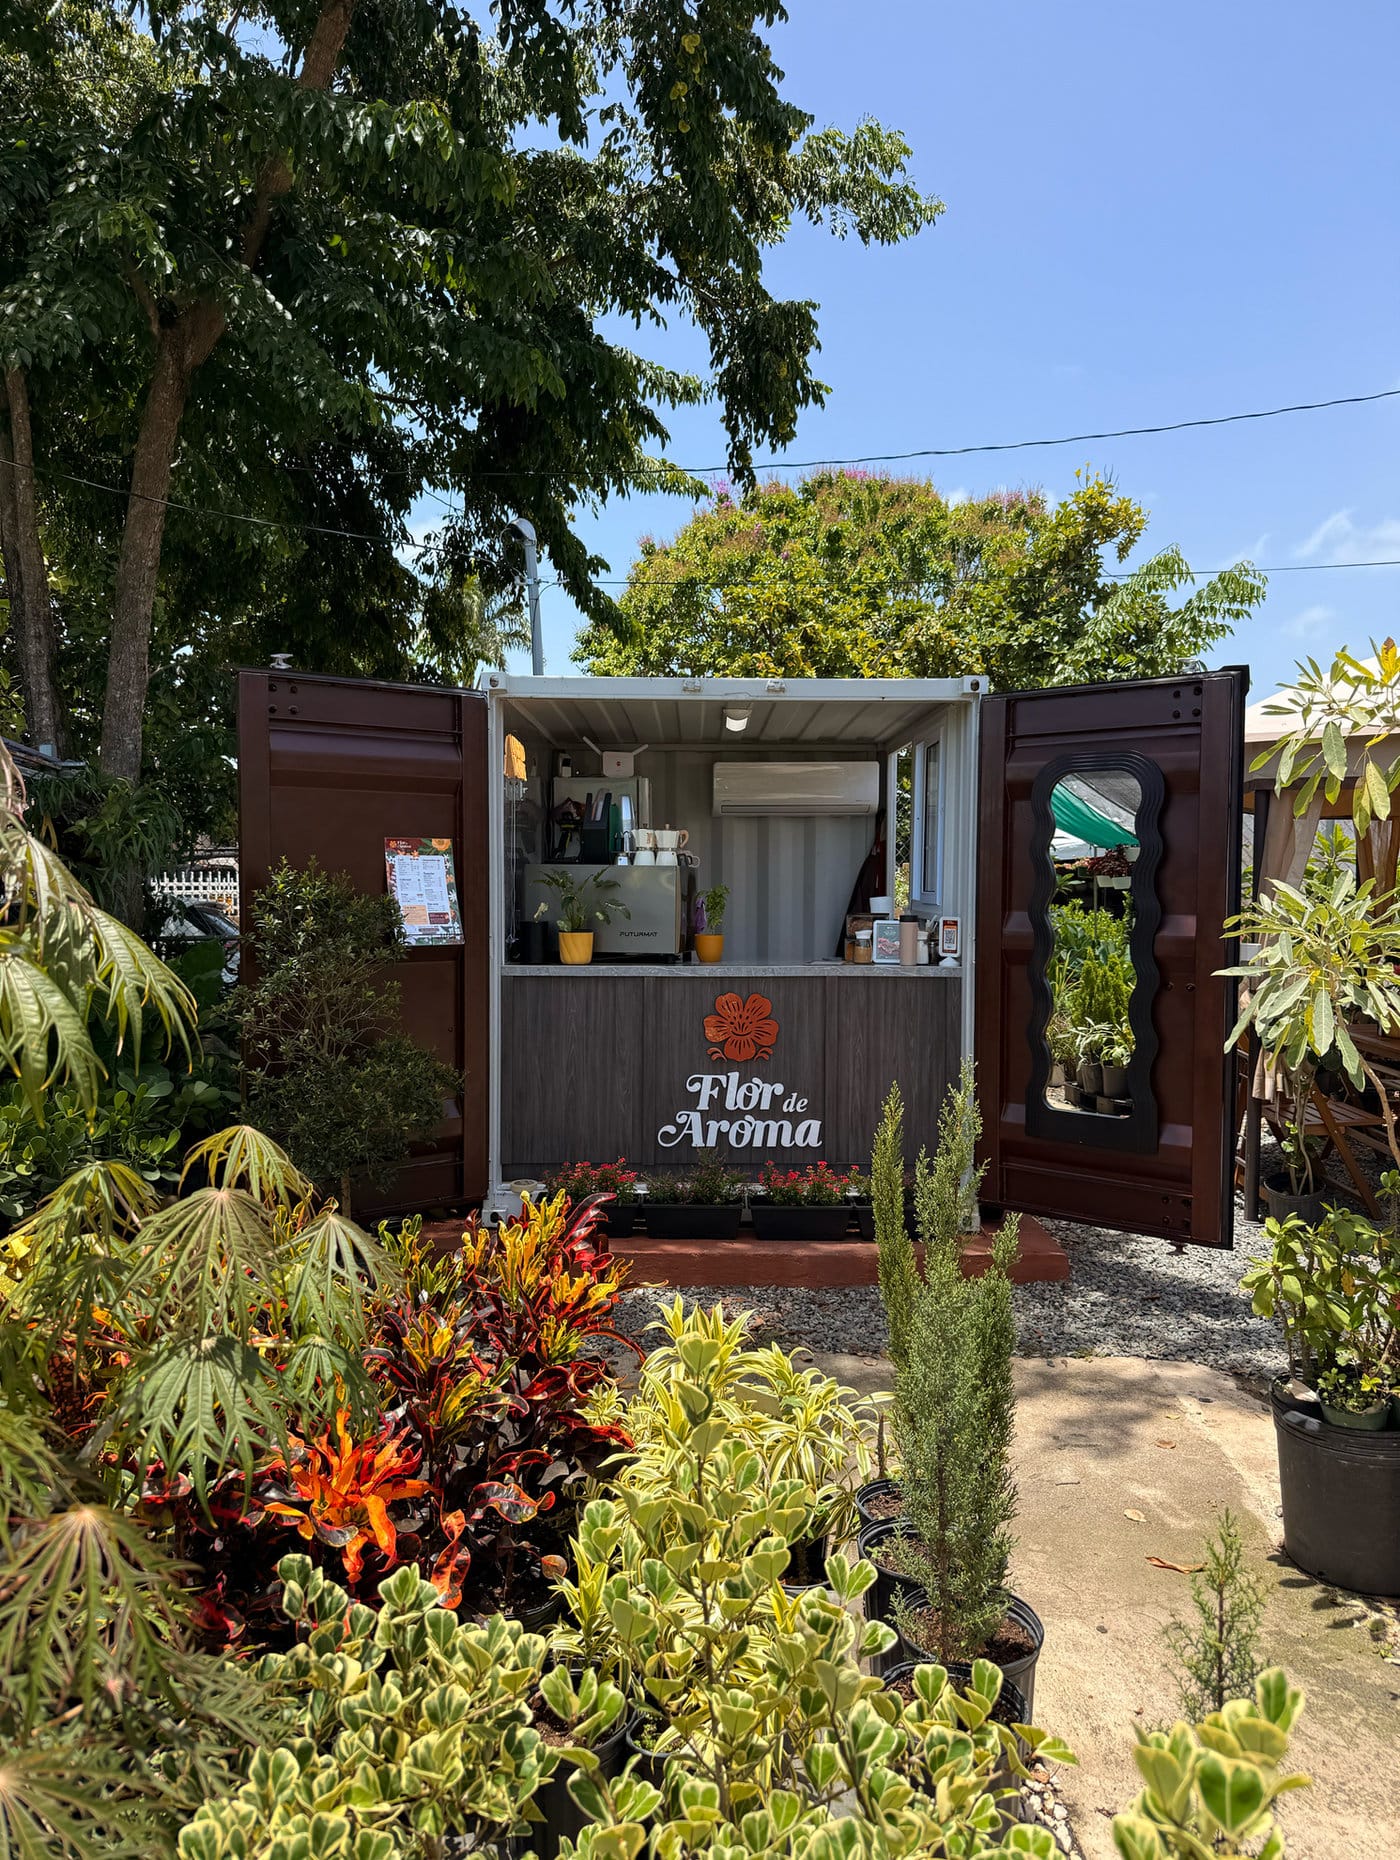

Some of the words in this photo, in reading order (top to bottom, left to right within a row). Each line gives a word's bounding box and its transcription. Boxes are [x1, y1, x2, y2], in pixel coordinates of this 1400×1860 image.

[686, 1071, 784, 1111] Flor
[782, 1093, 809, 1113] de
[657, 1110, 823, 1148] Aroma
